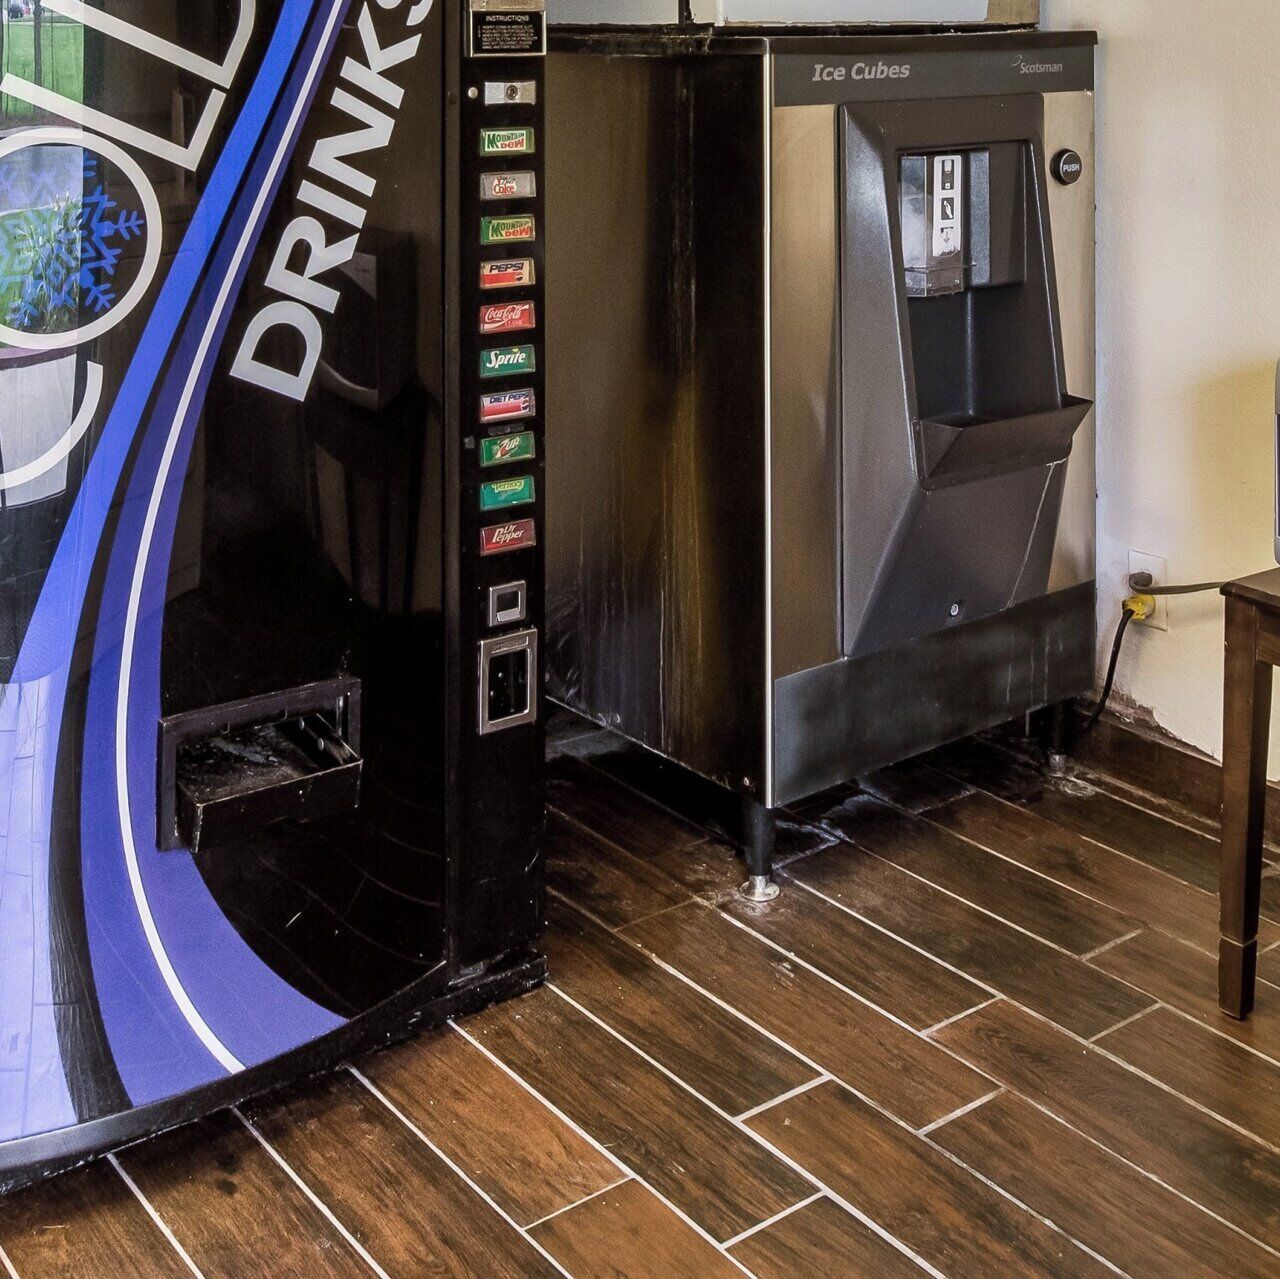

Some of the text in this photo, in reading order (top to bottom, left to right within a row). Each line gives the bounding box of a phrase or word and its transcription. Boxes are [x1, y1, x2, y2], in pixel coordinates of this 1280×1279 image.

[486, 14, 530, 22] INSTRUCTIONS
[811, 61, 910, 81] Ice Cubes
[1019, 62, 1063, 74] Scotsman
[1063, 162, 1080, 172] PUSH
[493, 184, 515, 194] Coke
[489, 262, 524, 273] PEPSI
[486, 349, 526, 368] Sprite
[489, 395, 508, 404] DIET
[504, 525, 517, 533] Dr
[491, 527, 524, 544] Pepper
